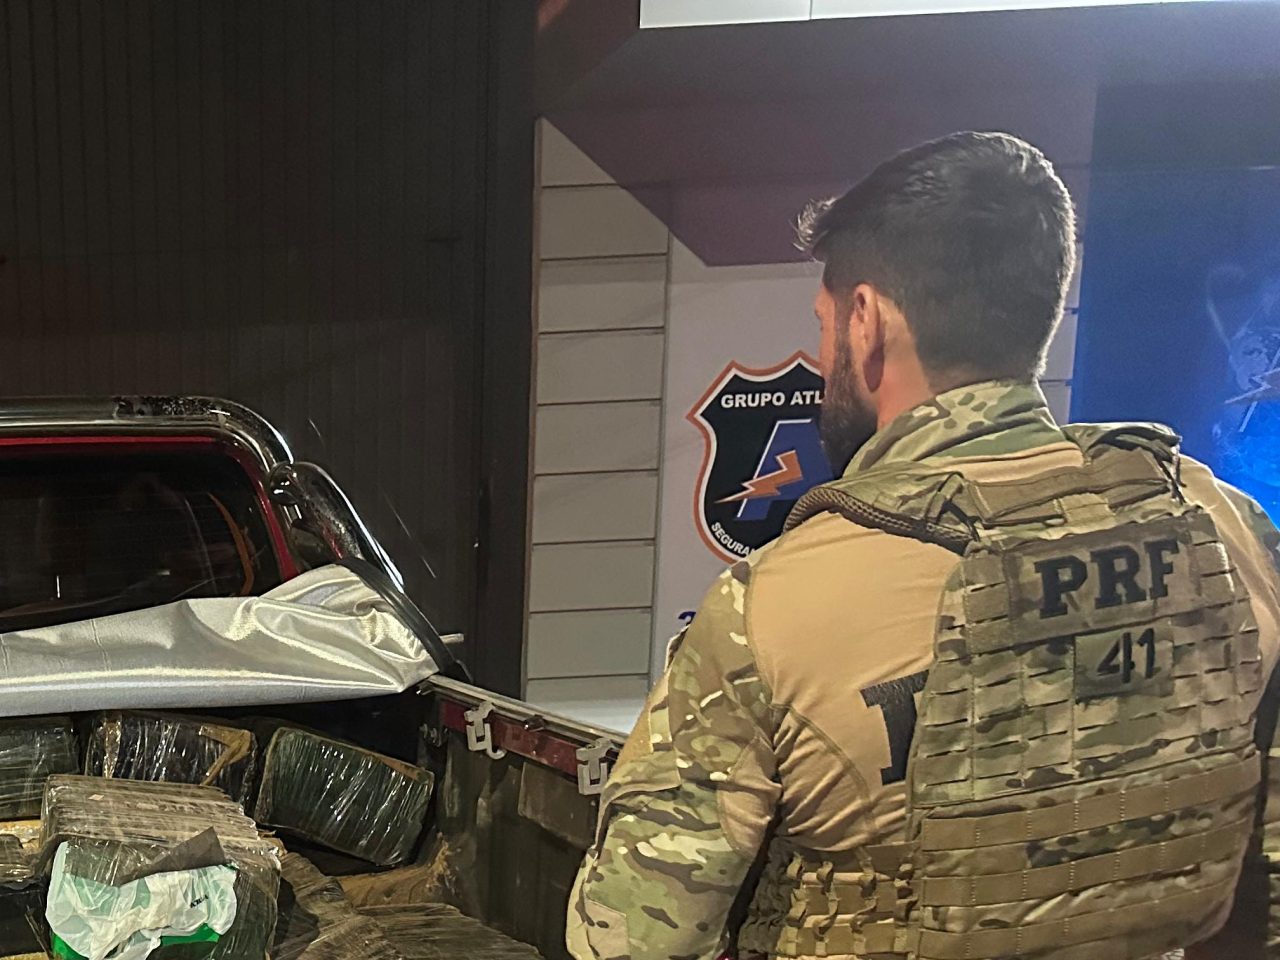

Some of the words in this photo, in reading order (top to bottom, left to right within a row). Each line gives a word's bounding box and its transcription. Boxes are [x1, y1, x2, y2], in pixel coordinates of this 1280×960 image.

[721, 392, 786, 408] GRUPO
[790, 390, 823, 406] ATL
[1034, 538, 1180, 620] PRF
[1097, 627, 1155, 683] 41
